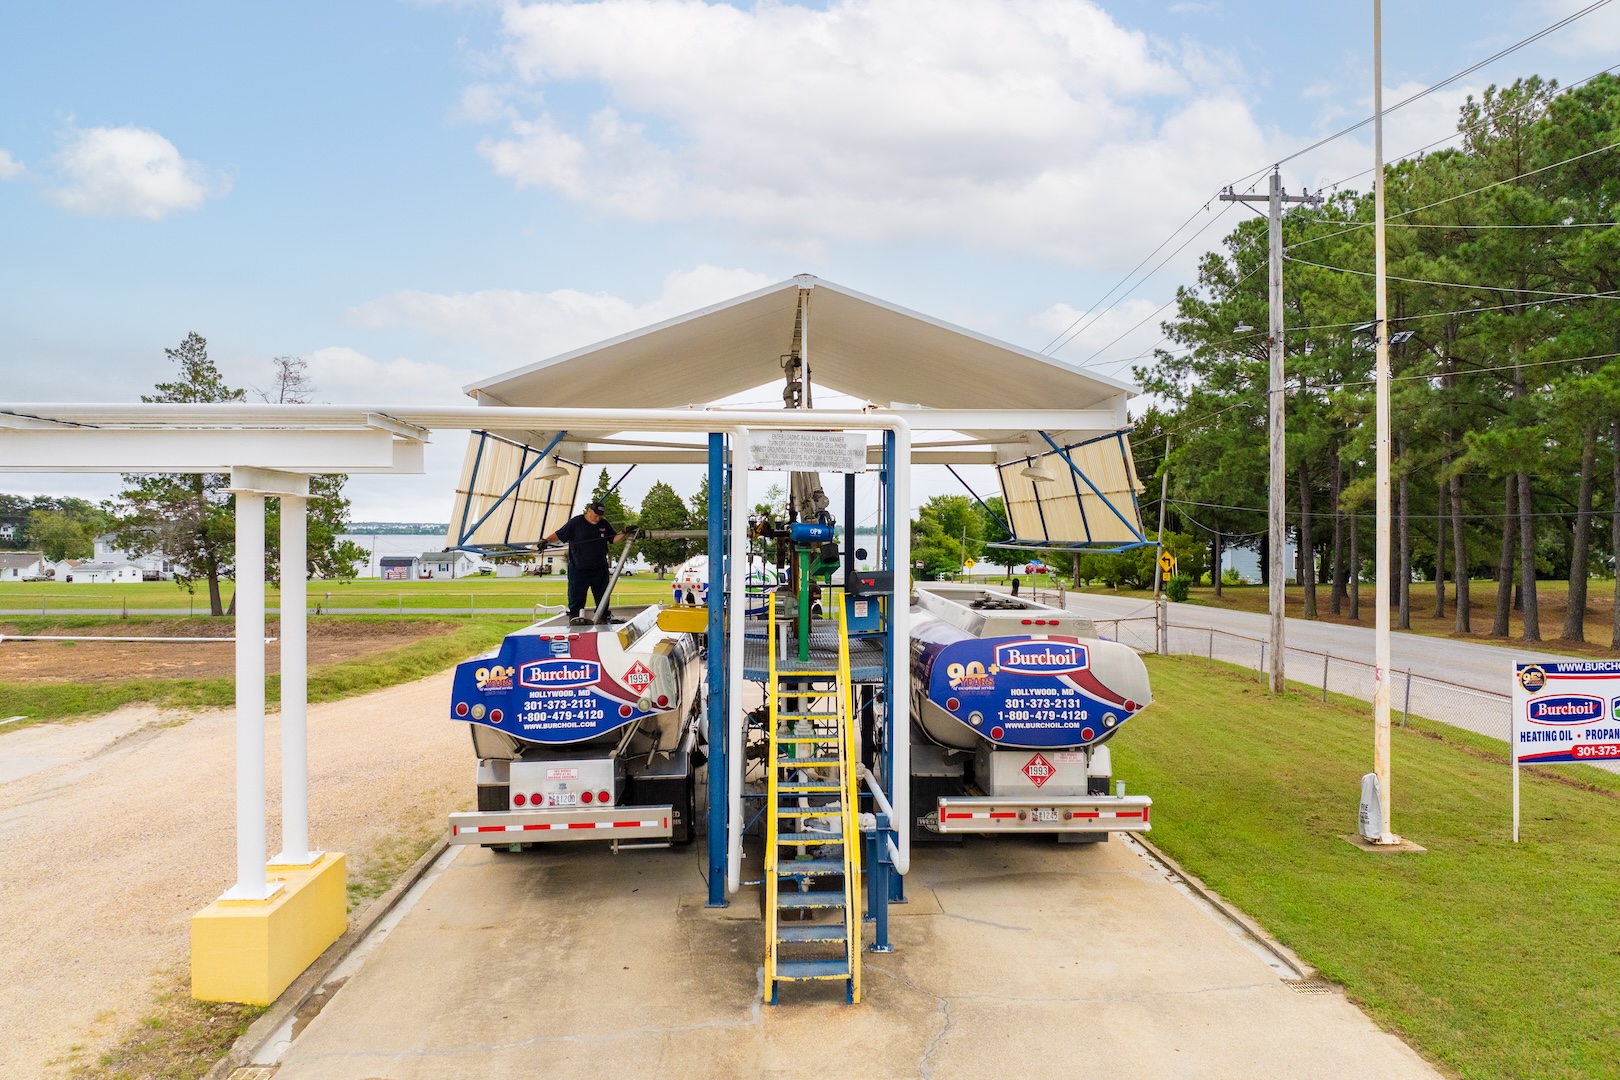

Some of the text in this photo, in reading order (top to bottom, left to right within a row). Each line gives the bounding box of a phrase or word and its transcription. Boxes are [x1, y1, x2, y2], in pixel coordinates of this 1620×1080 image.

[1008, 648, 1079, 666] Burchoil
[529, 665, 591, 682] Burchoil
[628, 673, 649, 684] 1993
[485, 678, 512, 688] YEARS
[960, 677, 995, 687] YEARS
[529, 690, 576, 698] HOLLYWOOD,
[1011, 688, 1059, 696] HOLLYWOOD,
[523, 699, 596, 711] 301-373-2131
[1005, 699, 1080, 708] 301-373-2131
[1538, 701, 1594, 716] Burchoil
[516, 710, 604, 722] 1-800-479-4120
[998, 711, 1088, 720] 1-800-479-4120
[523, 721, 596, 730] WWW.BURCHOIL.COM
[1520, 730, 1557, 742] HEATING
[1560, 730, 1573, 741] OIL
[1030, 767, 1048, 775] 1993
